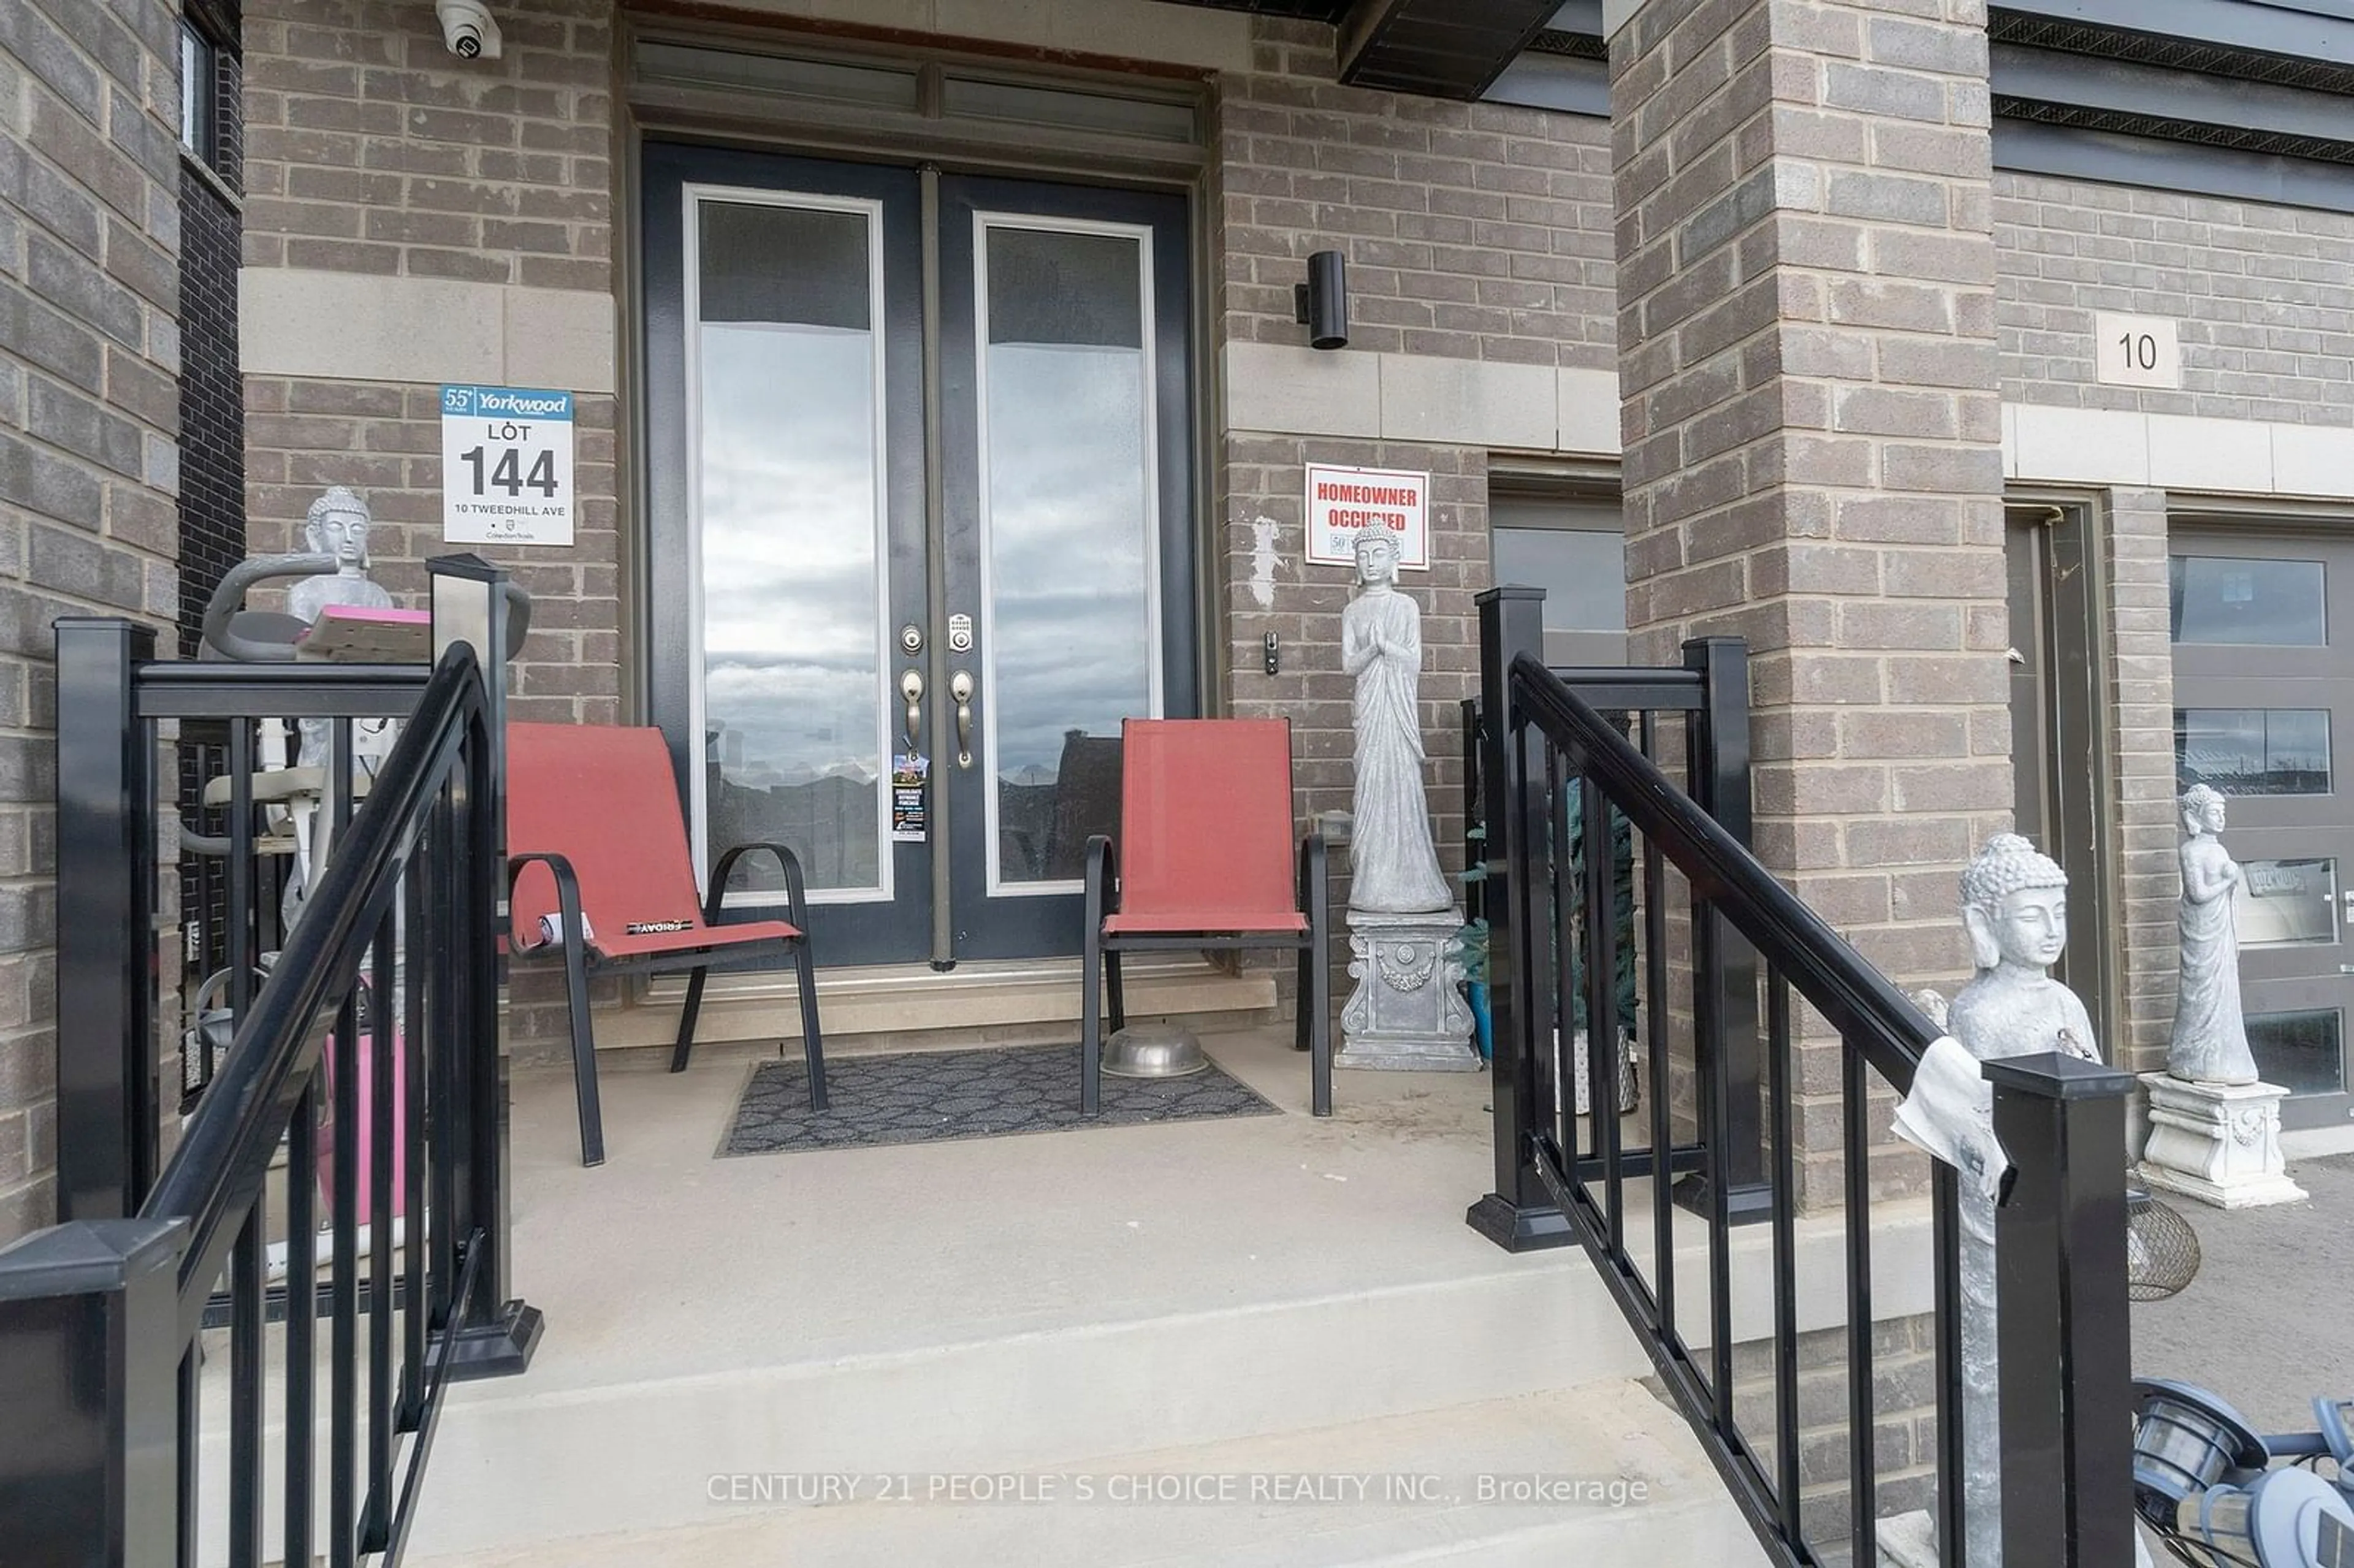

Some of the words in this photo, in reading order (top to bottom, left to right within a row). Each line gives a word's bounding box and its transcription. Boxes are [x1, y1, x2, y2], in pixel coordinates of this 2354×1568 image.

[2119, 333, 2156, 370] 10
[479, 392, 567, 415] Yorkwood
[488, 424, 531, 441] LOT
[460, 446, 558, 498] 144
[1318, 482, 1417, 507] HOMEOWNER
[455, 504, 468, 514] 10
[471, 504, 539, 516] TWEEDHILL
[541, 507, 565, 516] AVE
[641, 923, 682, 932] FRIDAY
